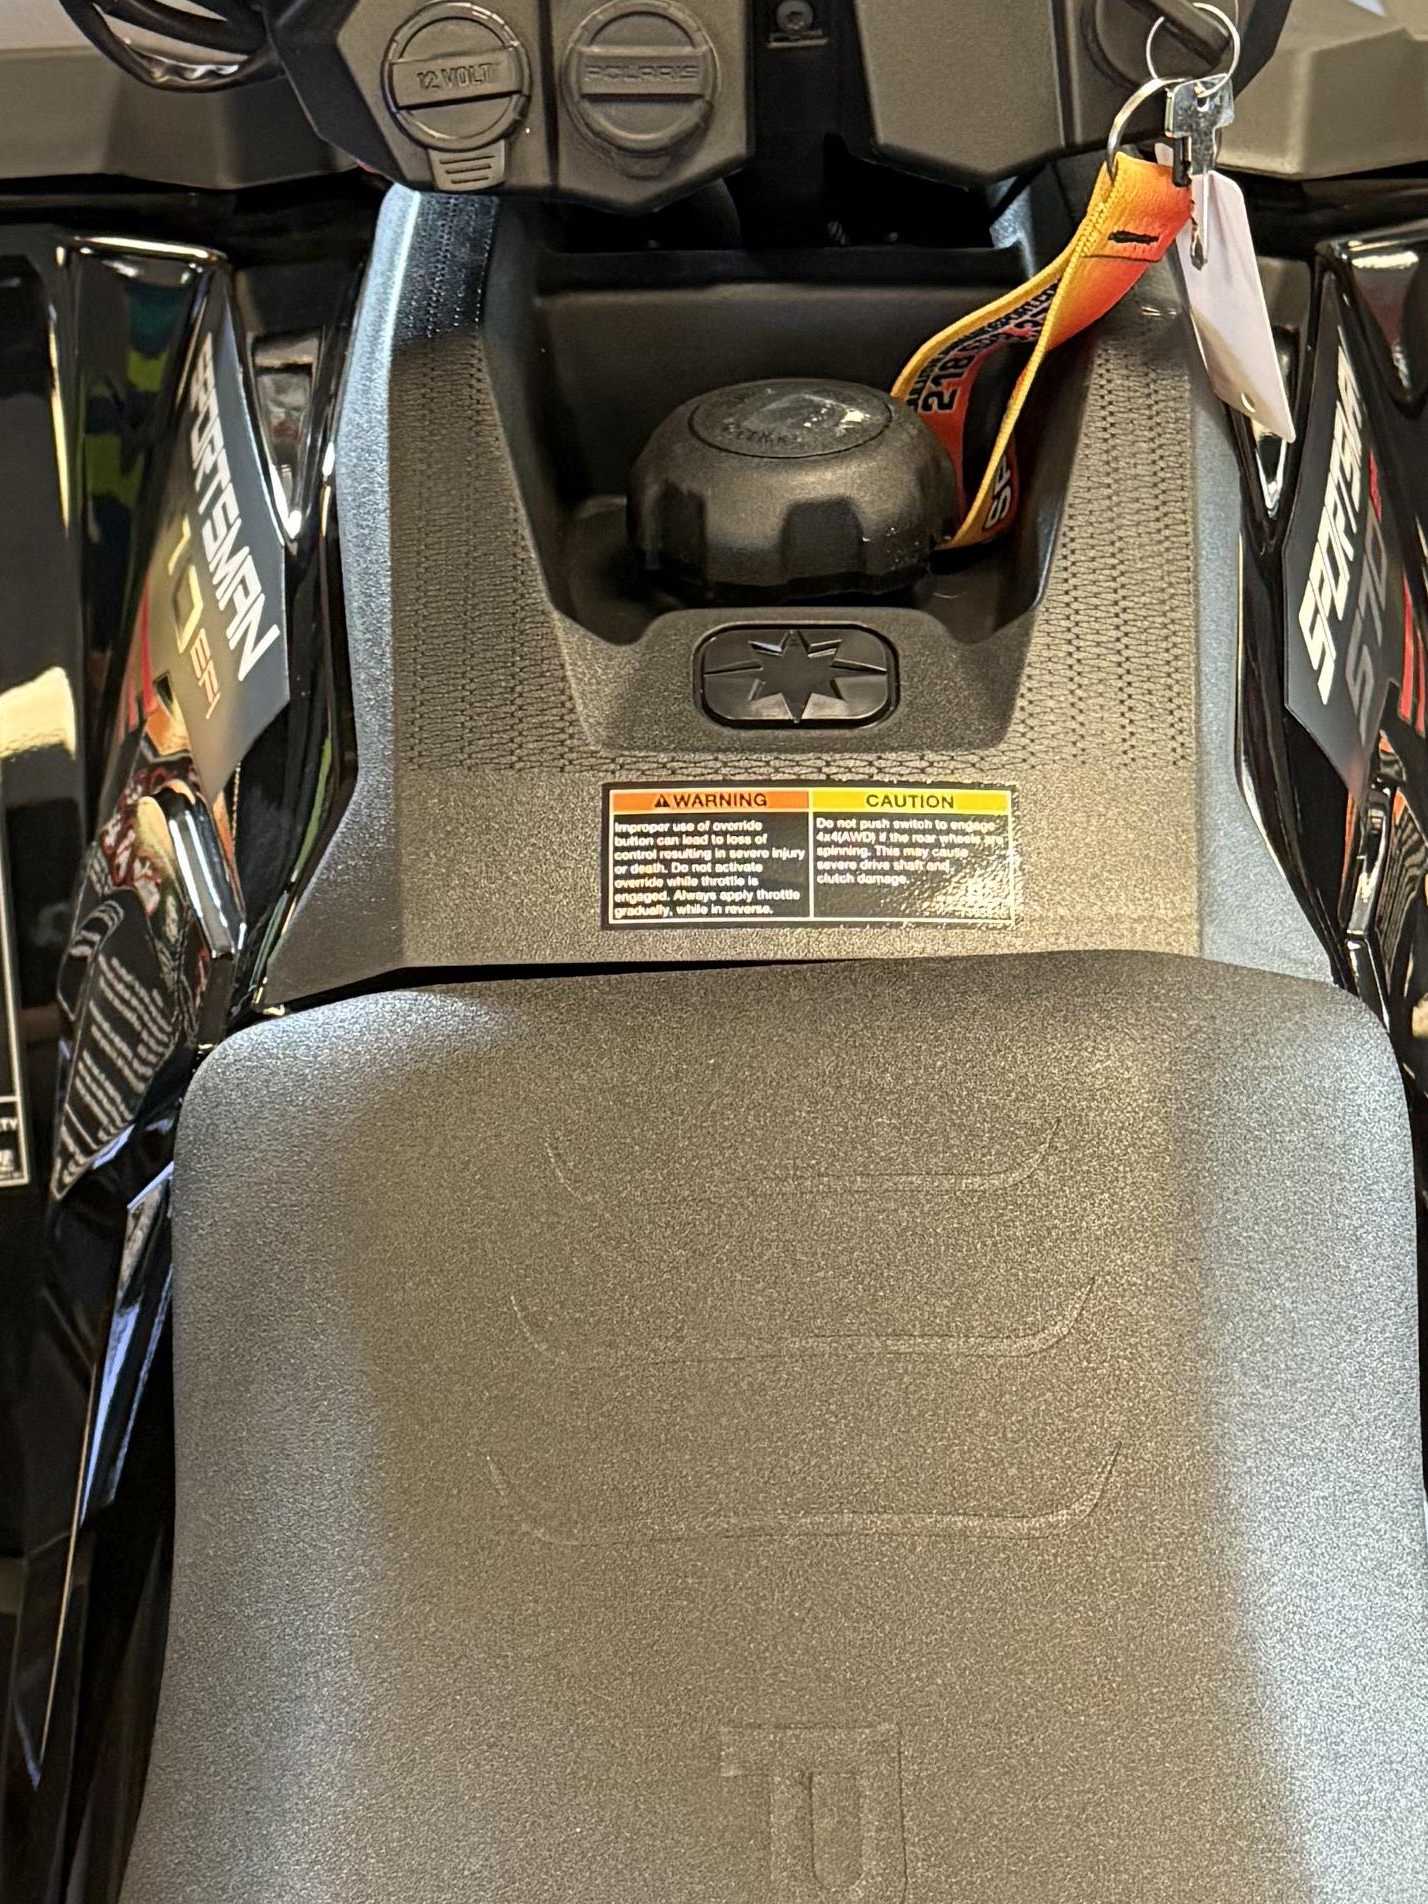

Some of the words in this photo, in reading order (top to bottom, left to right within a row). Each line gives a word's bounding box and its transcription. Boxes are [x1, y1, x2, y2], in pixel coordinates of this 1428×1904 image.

[416, 71, 440, 88] 12
[443, 63, 492, 89] VOLT
[587, 65, 699, 81] POLARIS
[189, 332, 280, 682] SPORTSMAN
[1345, 498, 1387, 746] 570
[190, 627, 221, 720] EFI
[673, 793, 767, 807] WARNING
[866, 795, 954, 809] CAUTION
[612, 821, 669, 835] Improper
[672, 823, 694, 831] use
[696, 821, 709, 831] of
[712, 820, 762, 831] override
[816, 818, 834, 828] Do
[836, 818, 856, 829] not
[859, 818, 890, 832] push
[892, 818, 932, 829] switch
[934, 818, 947, 829] to
[612, 835, 654, 846] button
[656, 837, 679, 845] can
[682, 834, 708, 845] lead
[710, 834, 724, 845] to
[726, 834, 751, 845] loss
[754, 834, 767, 844] of
[889, 832, 909, 843] the
[911, 835, 936, 844] rear
[611, 849, 656, 860] control
[659, 849, 712, 862] resulting
[714, 848, 726, 859] in
[729, 850, 769, 859] severe
[771, 848, 805, 861] injury
[816, 845, 871, 859] spinning.
[876, 846, 900, 857] This
[902, 848, 929, 860] may
[612, 865, 627, 874] or
[630, 863, 667, 873] death.
[671, 862, 688, 873] Do
[691, 862, 711, 873] not
[714, 862, 763, 872] activate
[816, 862, 856, 870] severe
[859, 859, 889, 870] drive
[612, 876, 663, 887] override
[666, 876, 698, 887] while
[700, 876, 745, 886] throttle
[747, 875, 758, 886] is
[816, 873, 854, 884] clutch
[612, 891, 669, 904] engaged.
[673, 890, 716, 904] Always
[719, 890, 753, 904] apply
[756, 890, 800, 900] throttle
[612, 904, 672, 918] gradually,
[676, 904, 708, 915] while
[710, 904, 722, 914] in
[724, 906, 773, 914] reverse.
